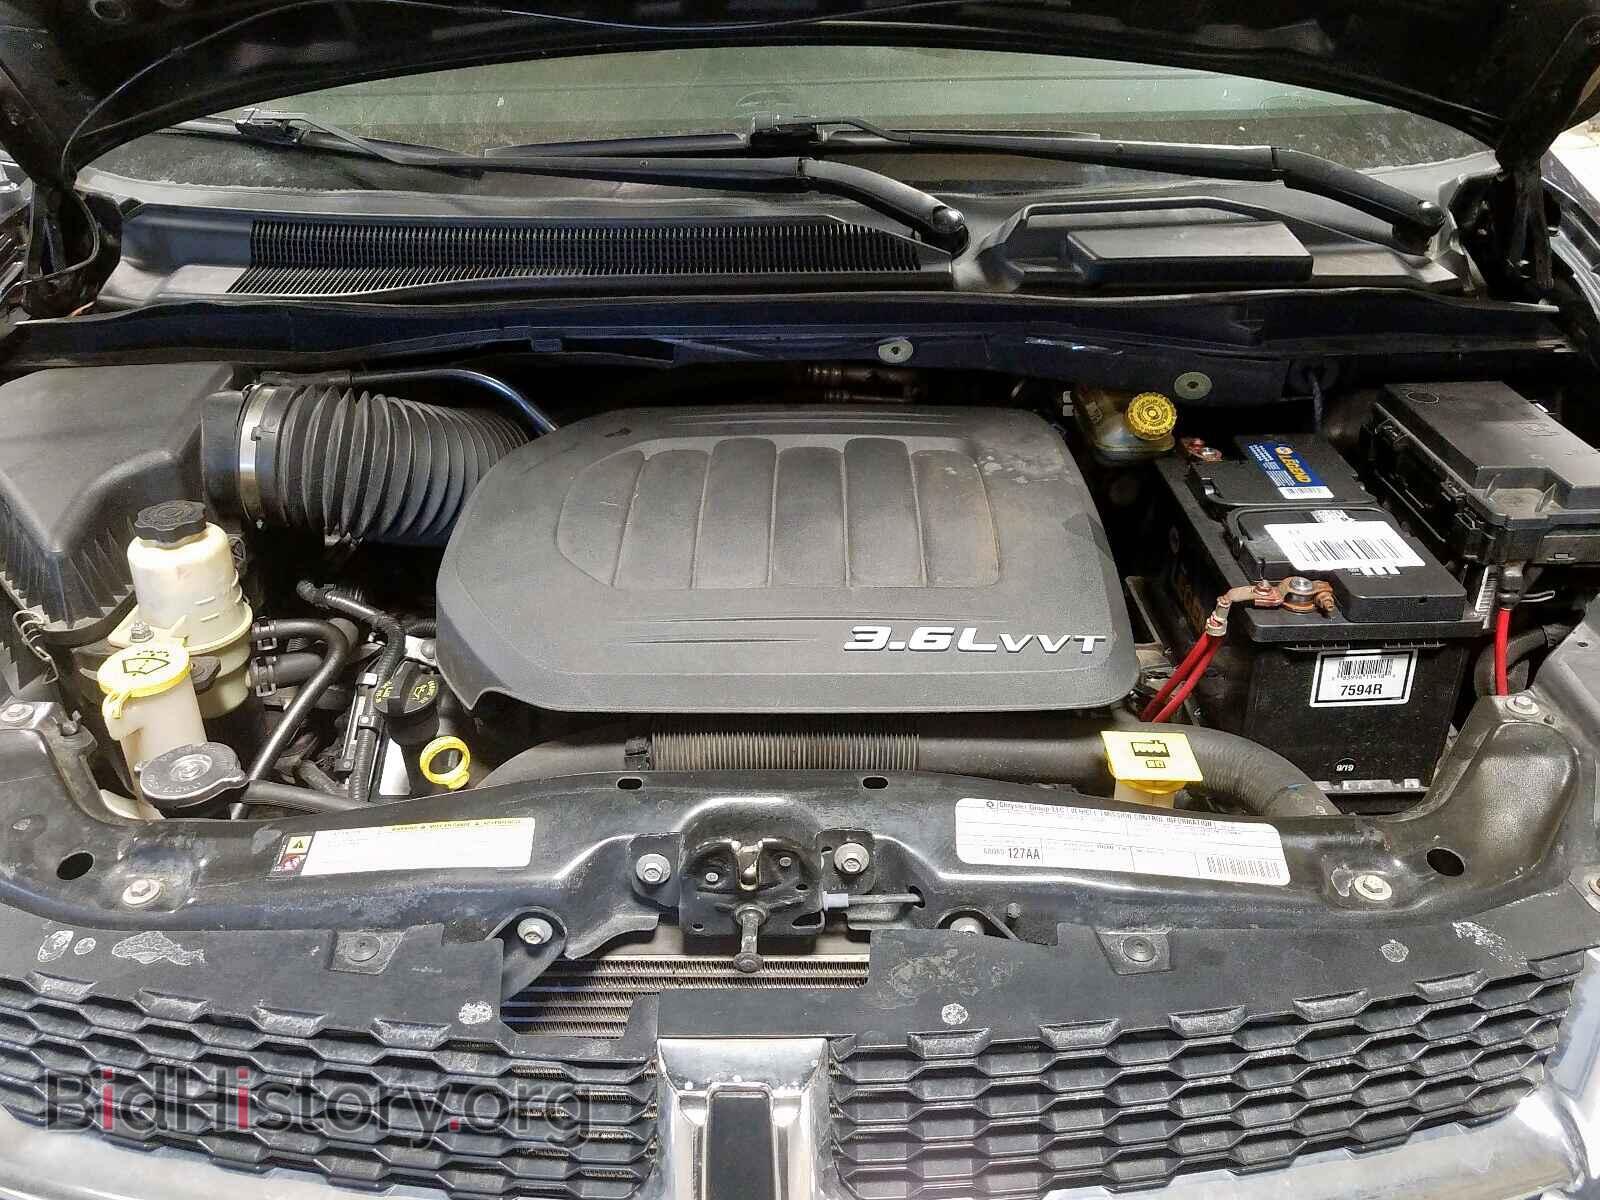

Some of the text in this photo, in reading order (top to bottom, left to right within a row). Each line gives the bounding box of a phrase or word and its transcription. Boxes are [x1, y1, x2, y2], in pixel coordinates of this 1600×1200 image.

[1279, 455, 1312, 483] LEGEND
[843, 625, 1107, 655] 3.6L VVT
[1340, 683, 1382, 696] 7594R
[1008, 847, 1040, 860] 127AA
